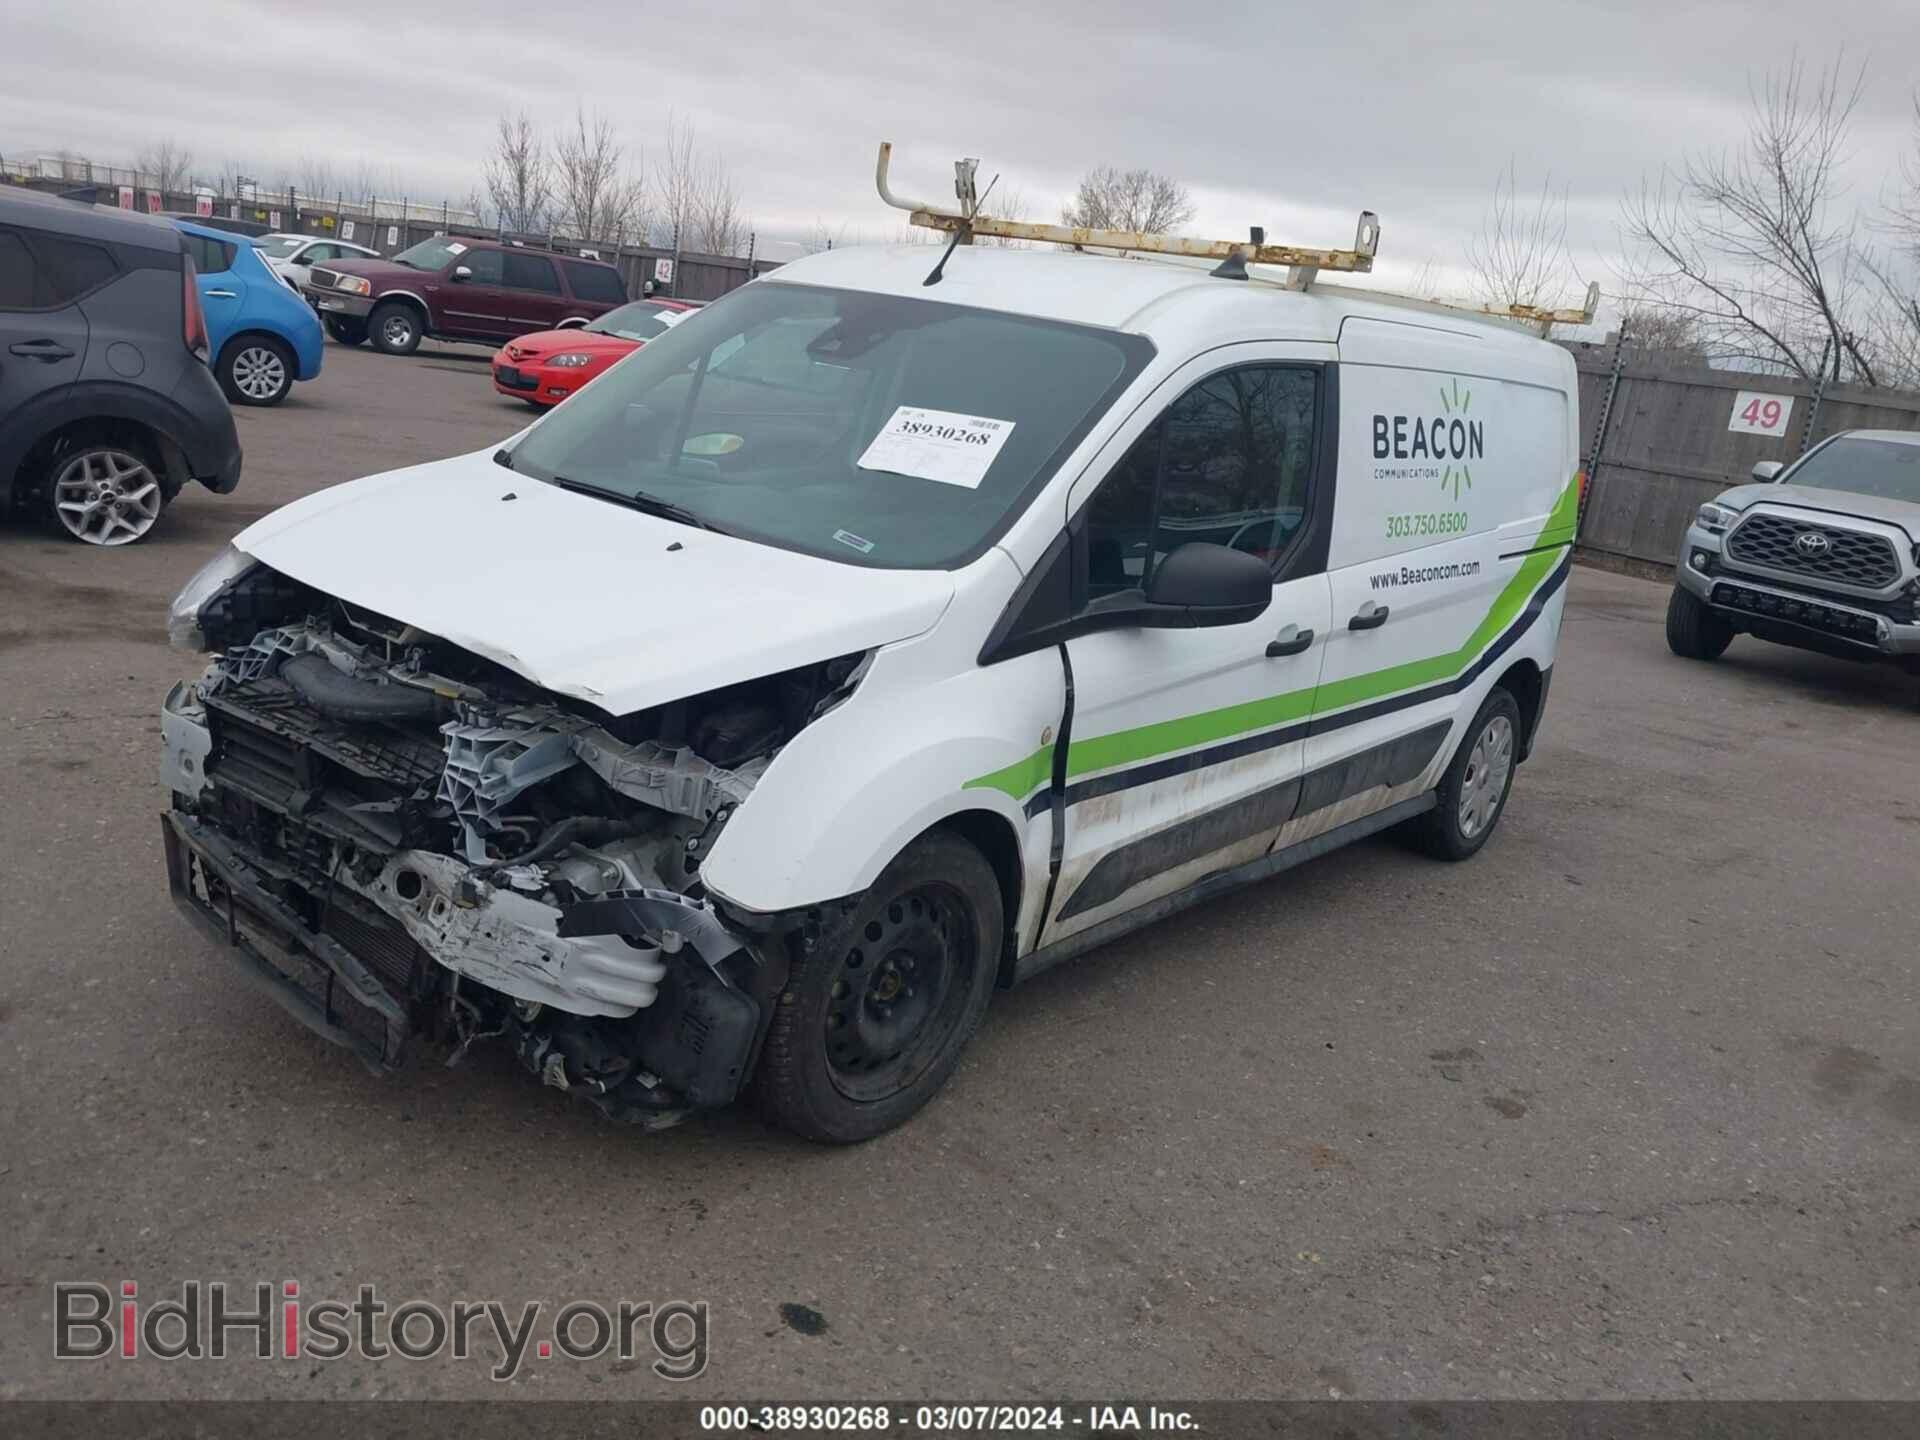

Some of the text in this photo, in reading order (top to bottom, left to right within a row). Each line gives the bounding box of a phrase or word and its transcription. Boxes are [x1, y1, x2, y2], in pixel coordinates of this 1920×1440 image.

[1742, 399, 1781, 428] 49
[896, 420, 991, 445] 38930268
[1373, 414, 1483, 460] BEACON
[1374, 468, 1439, 479] COMMUNICATIONS
[1386, 512, 1467, 538] 303.750.6500
[1370, 561, 1480, 590] www.Beaconcom.com
